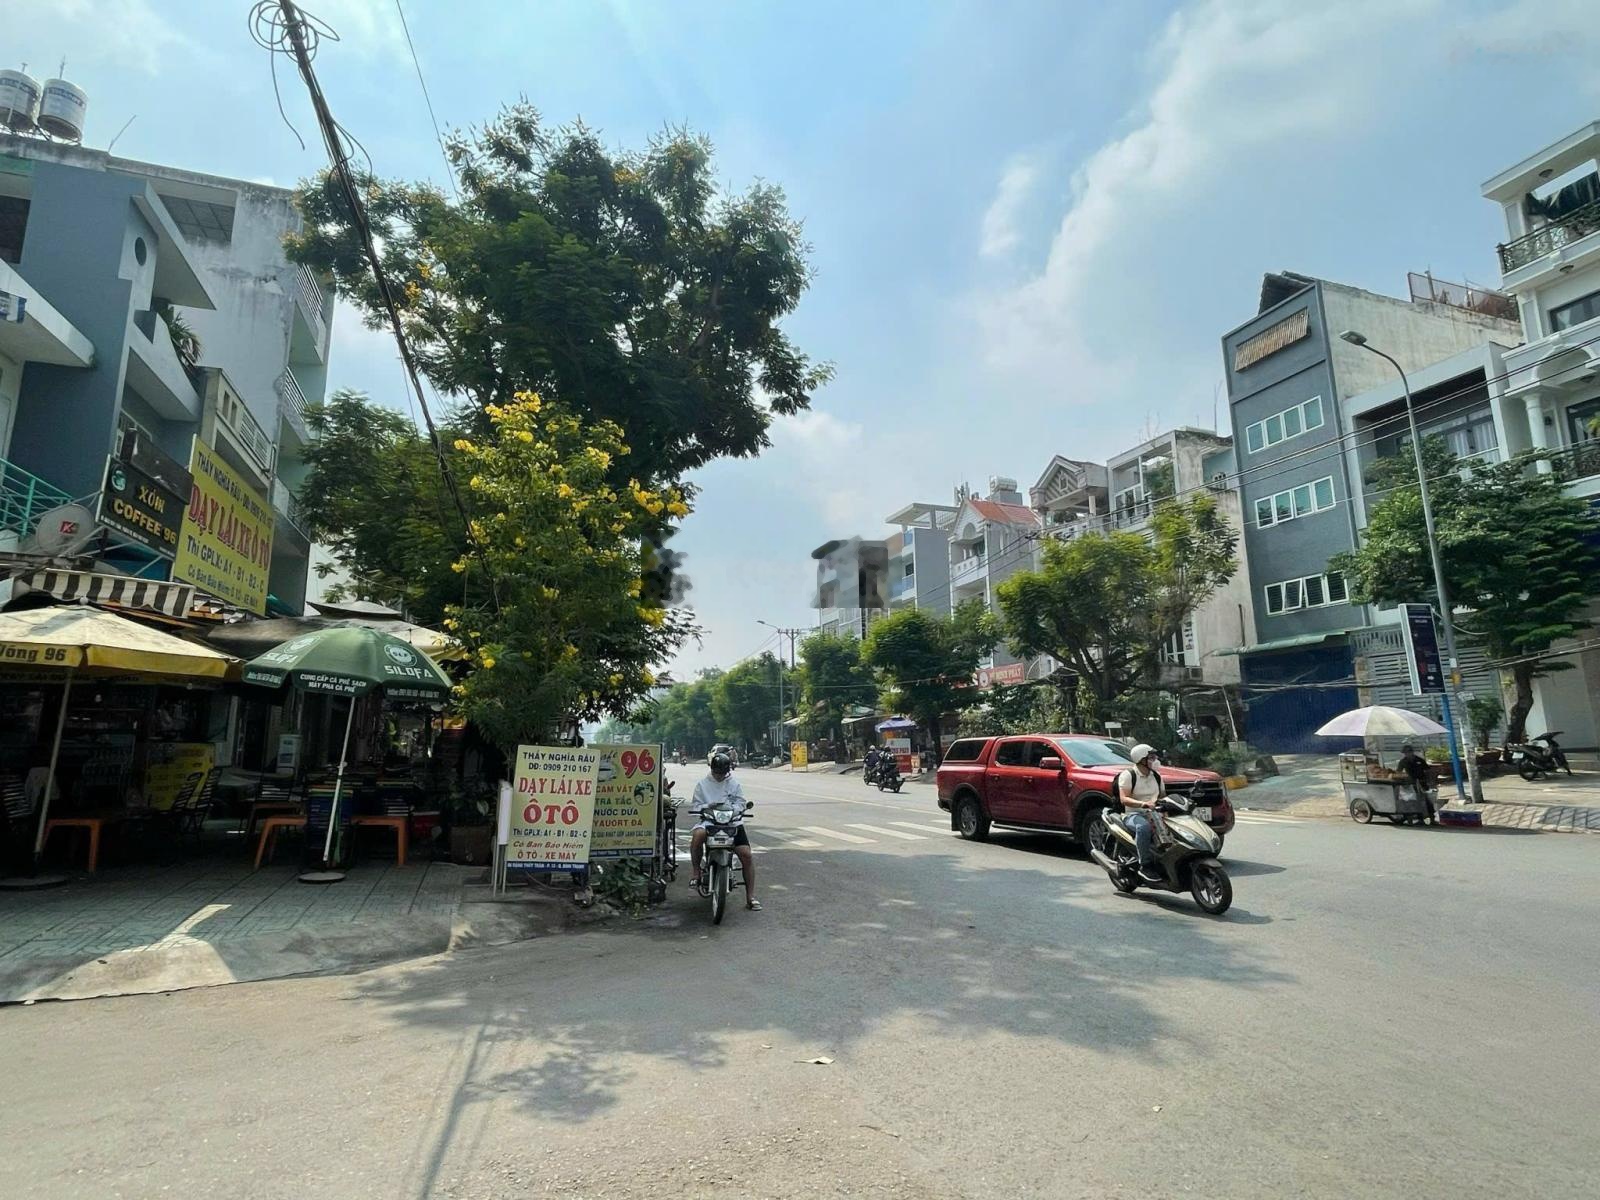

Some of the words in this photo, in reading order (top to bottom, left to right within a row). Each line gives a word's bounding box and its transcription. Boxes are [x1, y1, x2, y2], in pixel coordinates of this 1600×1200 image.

[113, 498, 162, 537] COFFEE
[163, 527, 177, 545] 96
[188, 484, 219, 536] DẠY
[217, 504, 238, 550] LÁI
[187, 535, 200, 556] Thi
[201, 545, 223, 570] GPLX:
[44, 647, 67, 661] 96
[384, 665, 433, 679] SILOFA
[620, 749, 655, 778] 96
[519, 777, 547, 796] DẠY
[550, 775, 573, 795] LÁI
[574, 780, 592, 795] XE
[513, 828, 522, 836] Thi
[582, 830, 588, 838] C
[545, 851, 557, 860] XE
